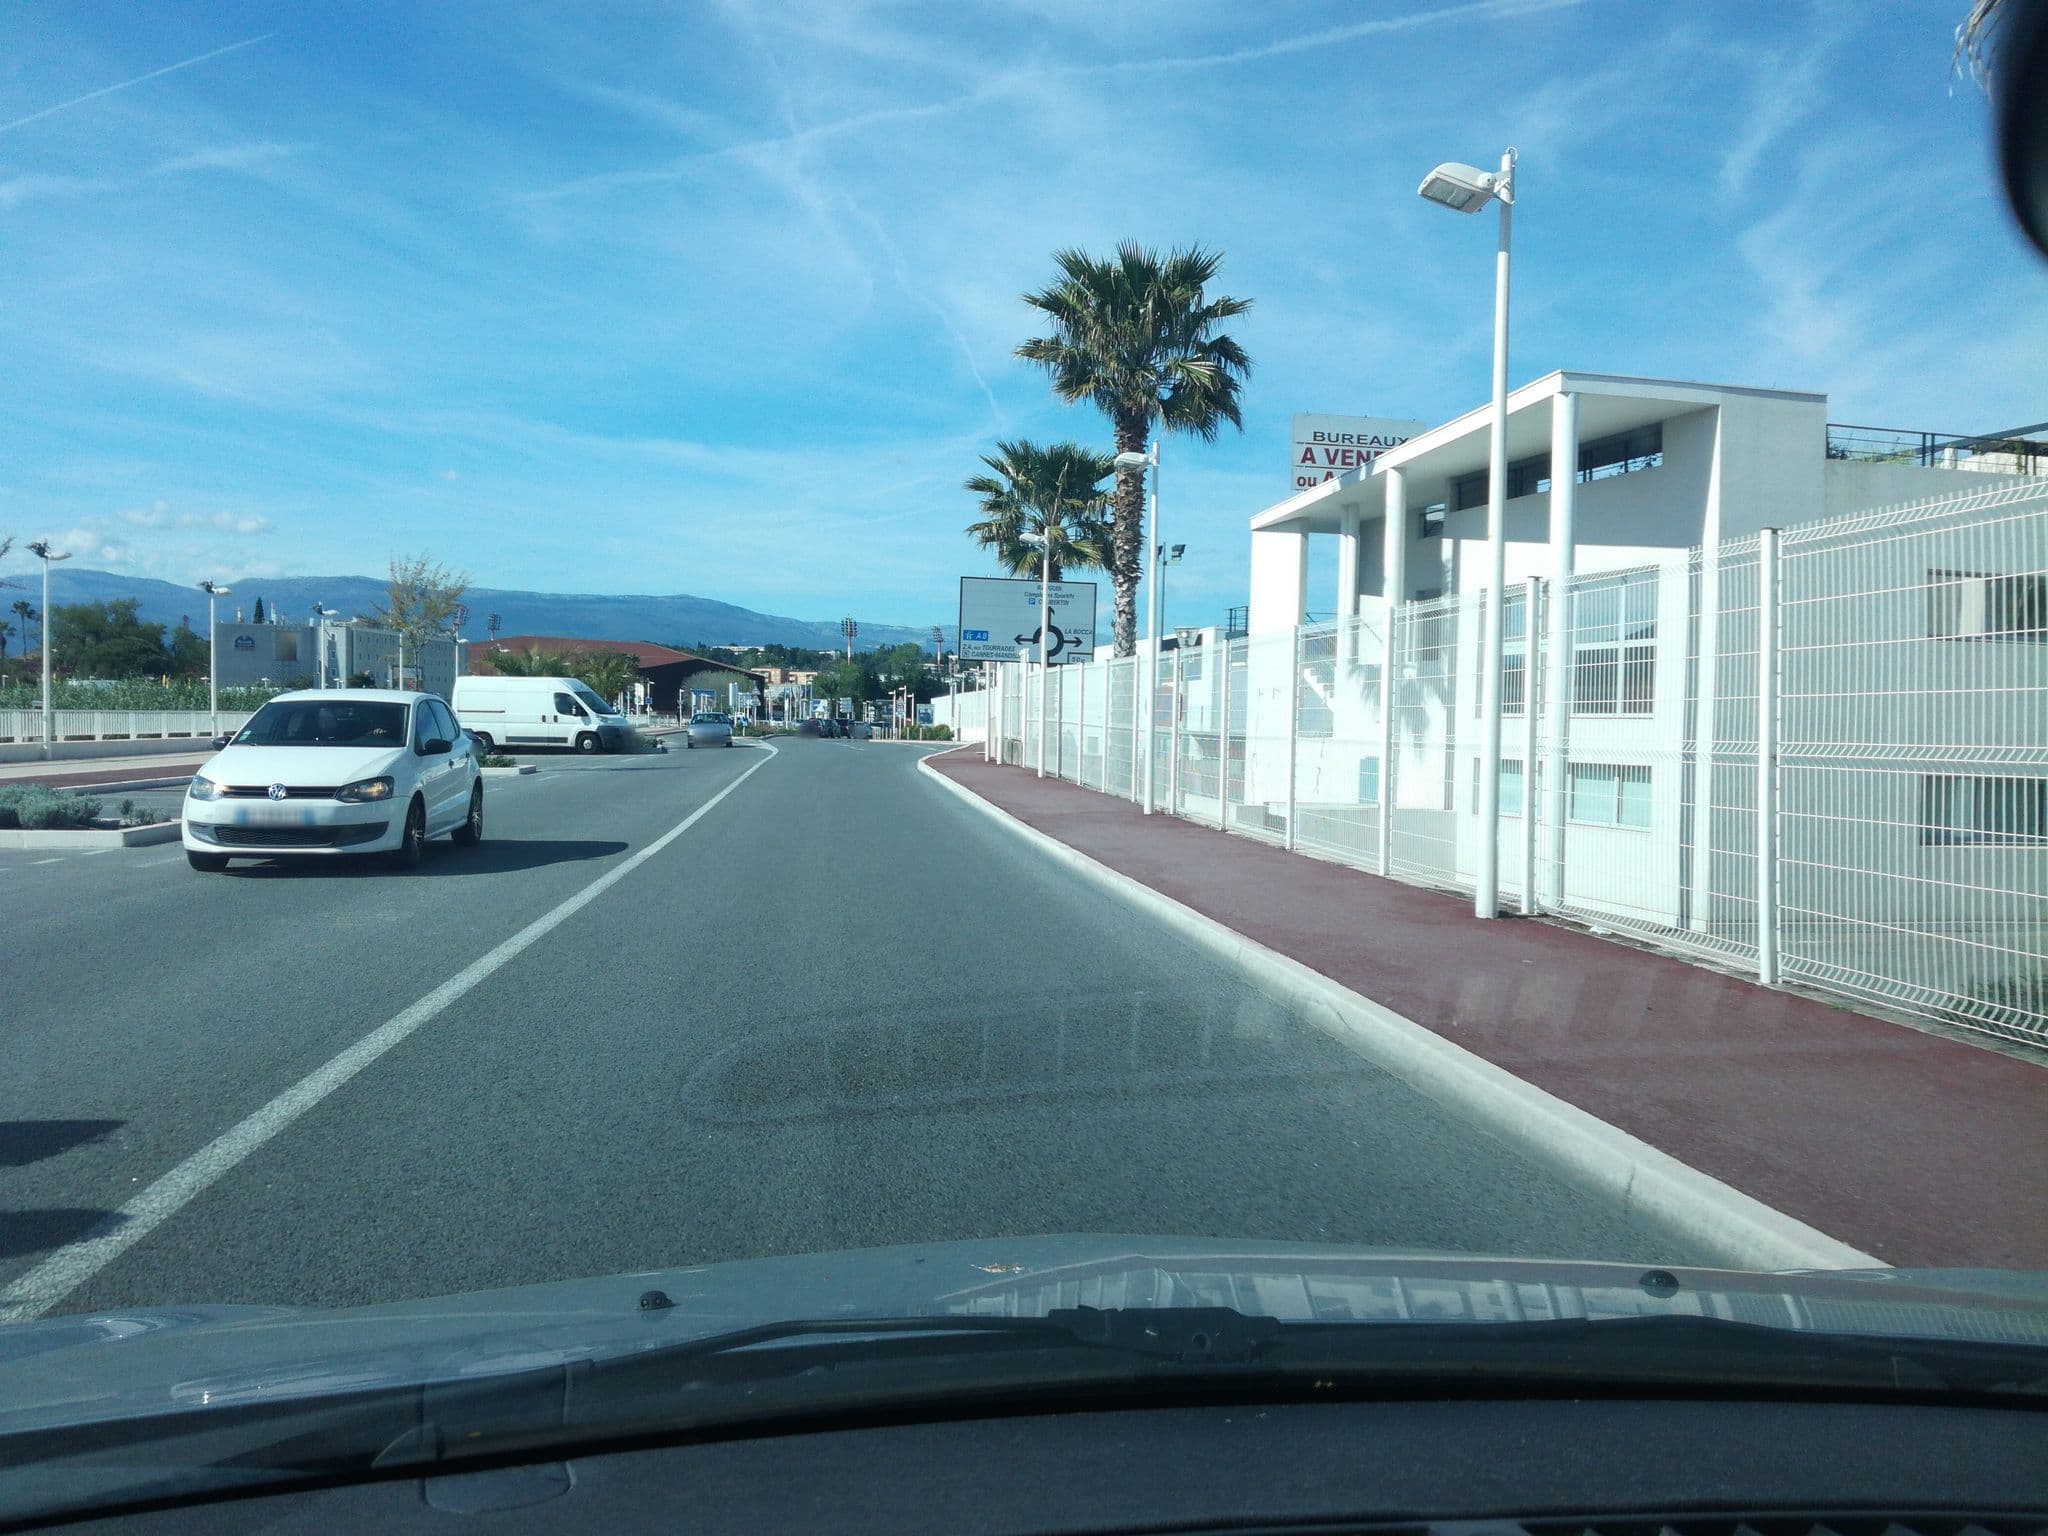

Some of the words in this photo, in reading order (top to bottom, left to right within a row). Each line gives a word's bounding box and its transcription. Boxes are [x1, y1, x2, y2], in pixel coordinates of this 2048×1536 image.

[1313, 431, 1409, 446] BUREAUX
[1301, 447, 1316, 464] A
[1324, 448, 1384, 466] VEN
[976, 632, 988, 640] A8
